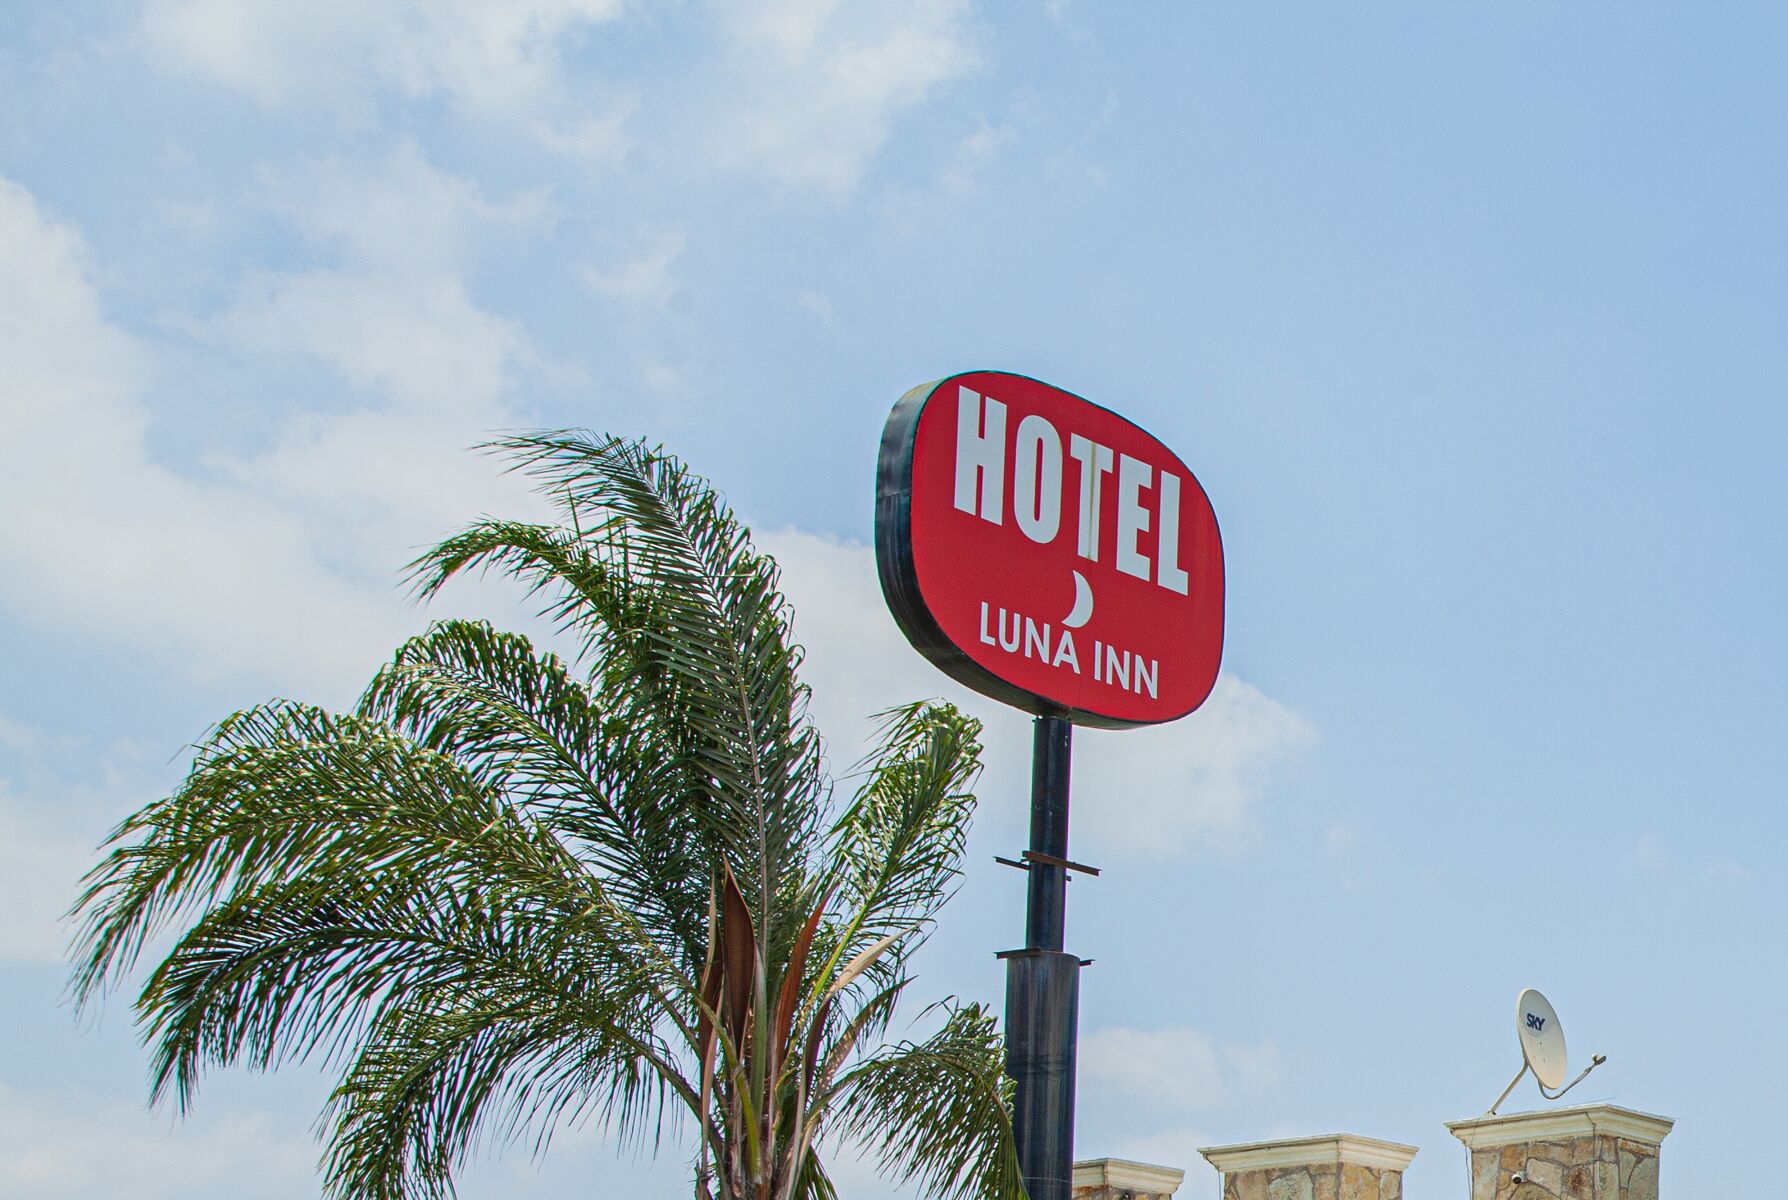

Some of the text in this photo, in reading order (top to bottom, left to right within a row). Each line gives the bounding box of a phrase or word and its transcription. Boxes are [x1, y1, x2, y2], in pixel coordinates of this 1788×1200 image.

[954, 385, 1188, 596] HOTEL
[980, 601, 1158, 700] LUNA INN
[1526, 1013, 1546, 1031] SKY
